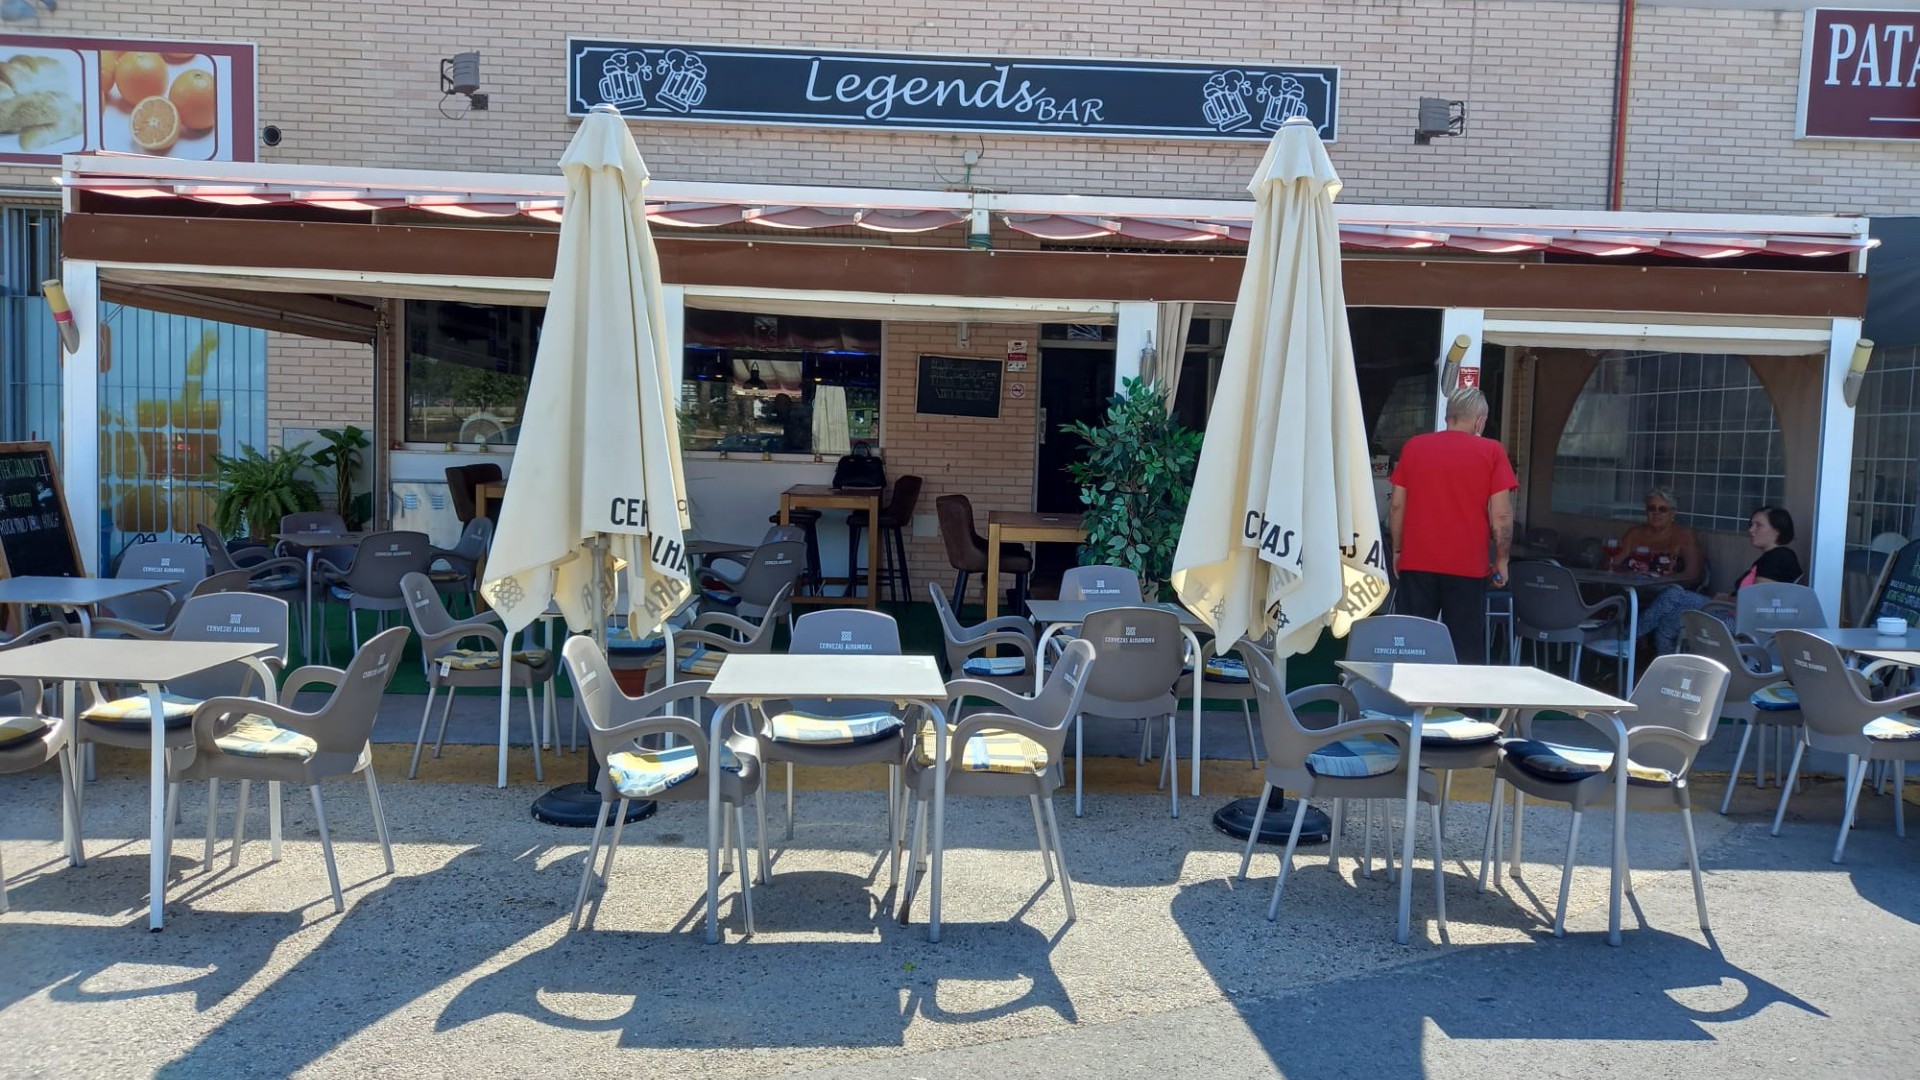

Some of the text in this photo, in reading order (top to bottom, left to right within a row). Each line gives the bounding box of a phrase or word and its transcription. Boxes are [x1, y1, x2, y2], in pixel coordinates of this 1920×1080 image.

[805, 58, 1105, 124] Legends BAR
[819, 642, 844, 651] CERVEZAS
